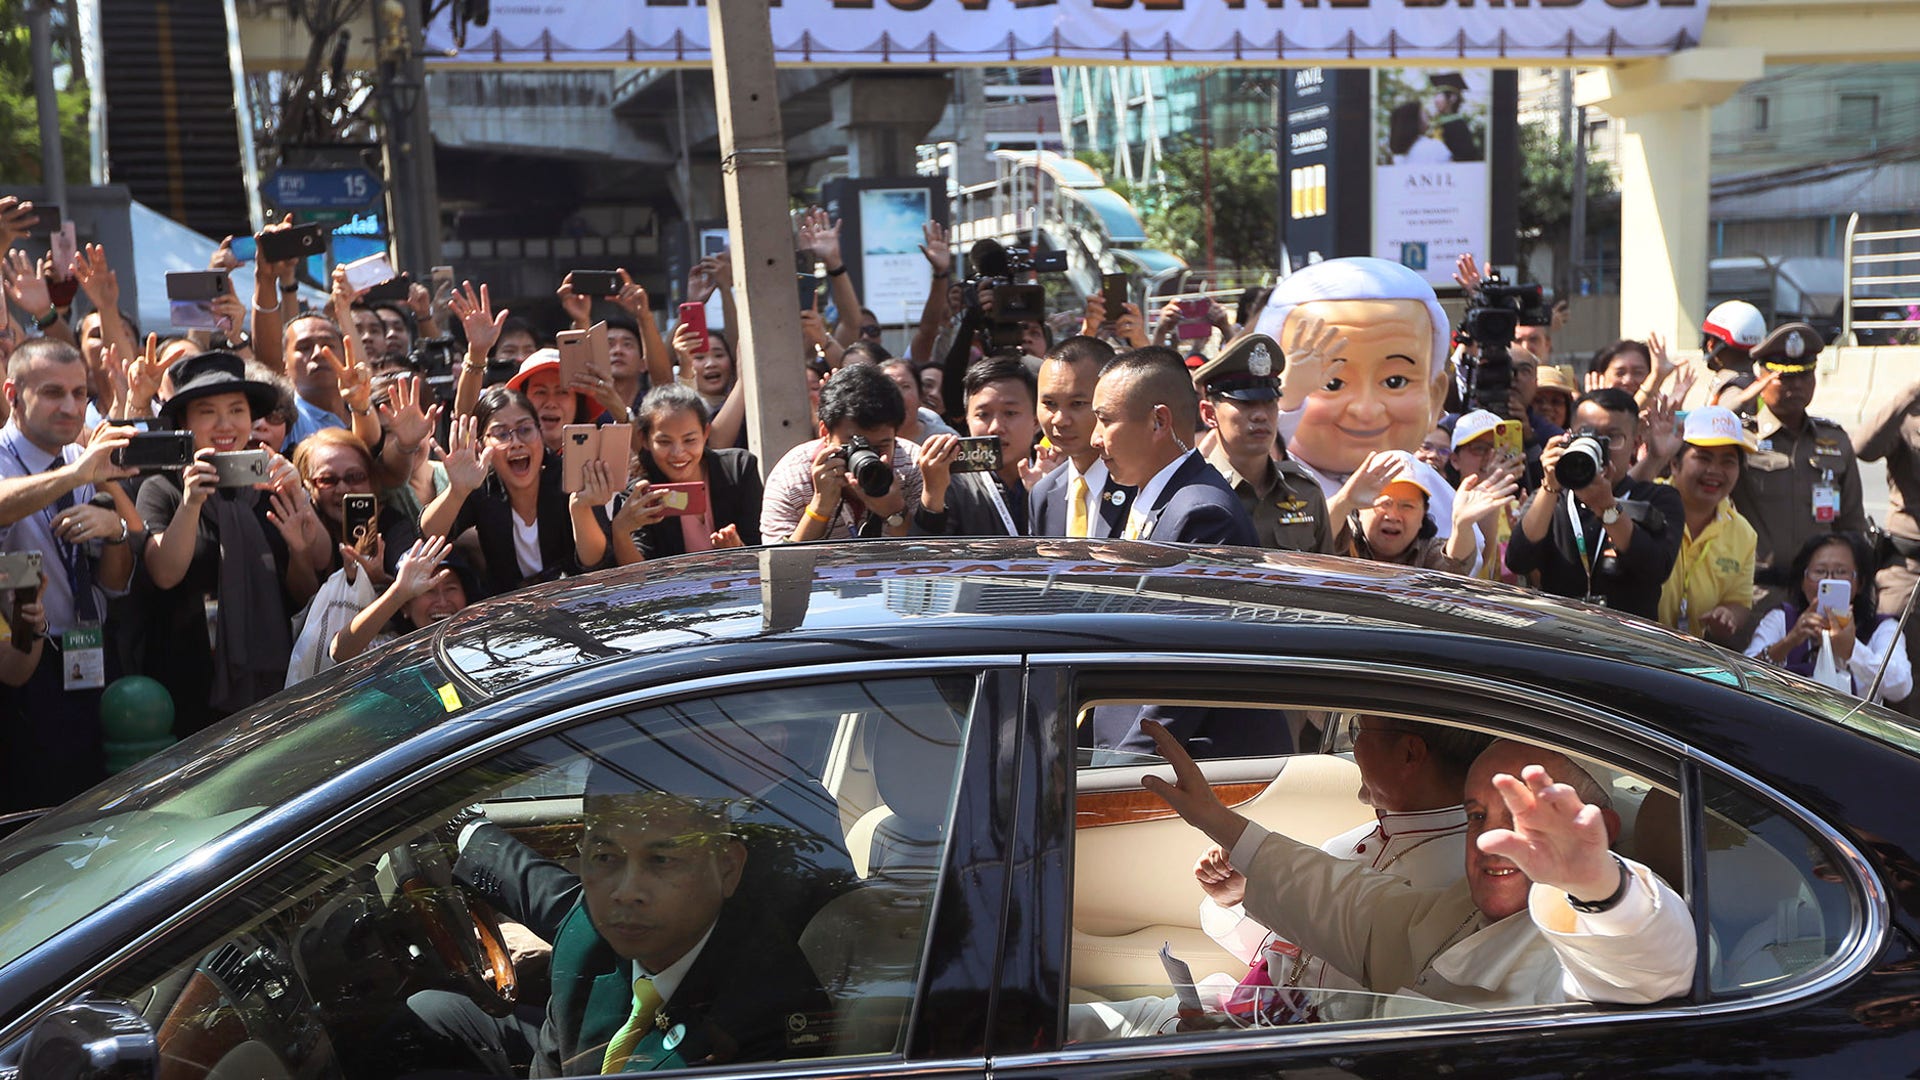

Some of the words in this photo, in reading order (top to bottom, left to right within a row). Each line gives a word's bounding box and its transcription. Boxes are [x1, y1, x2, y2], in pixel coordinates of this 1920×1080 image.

[1295, 66, 1325, 89] ANIL
[343, 174, 367, 197] 15
[1405, 172, 1456, 187] ANIL
[955, 446, 997, 465] Supre
[70, 634, 96, 646] PRESS
